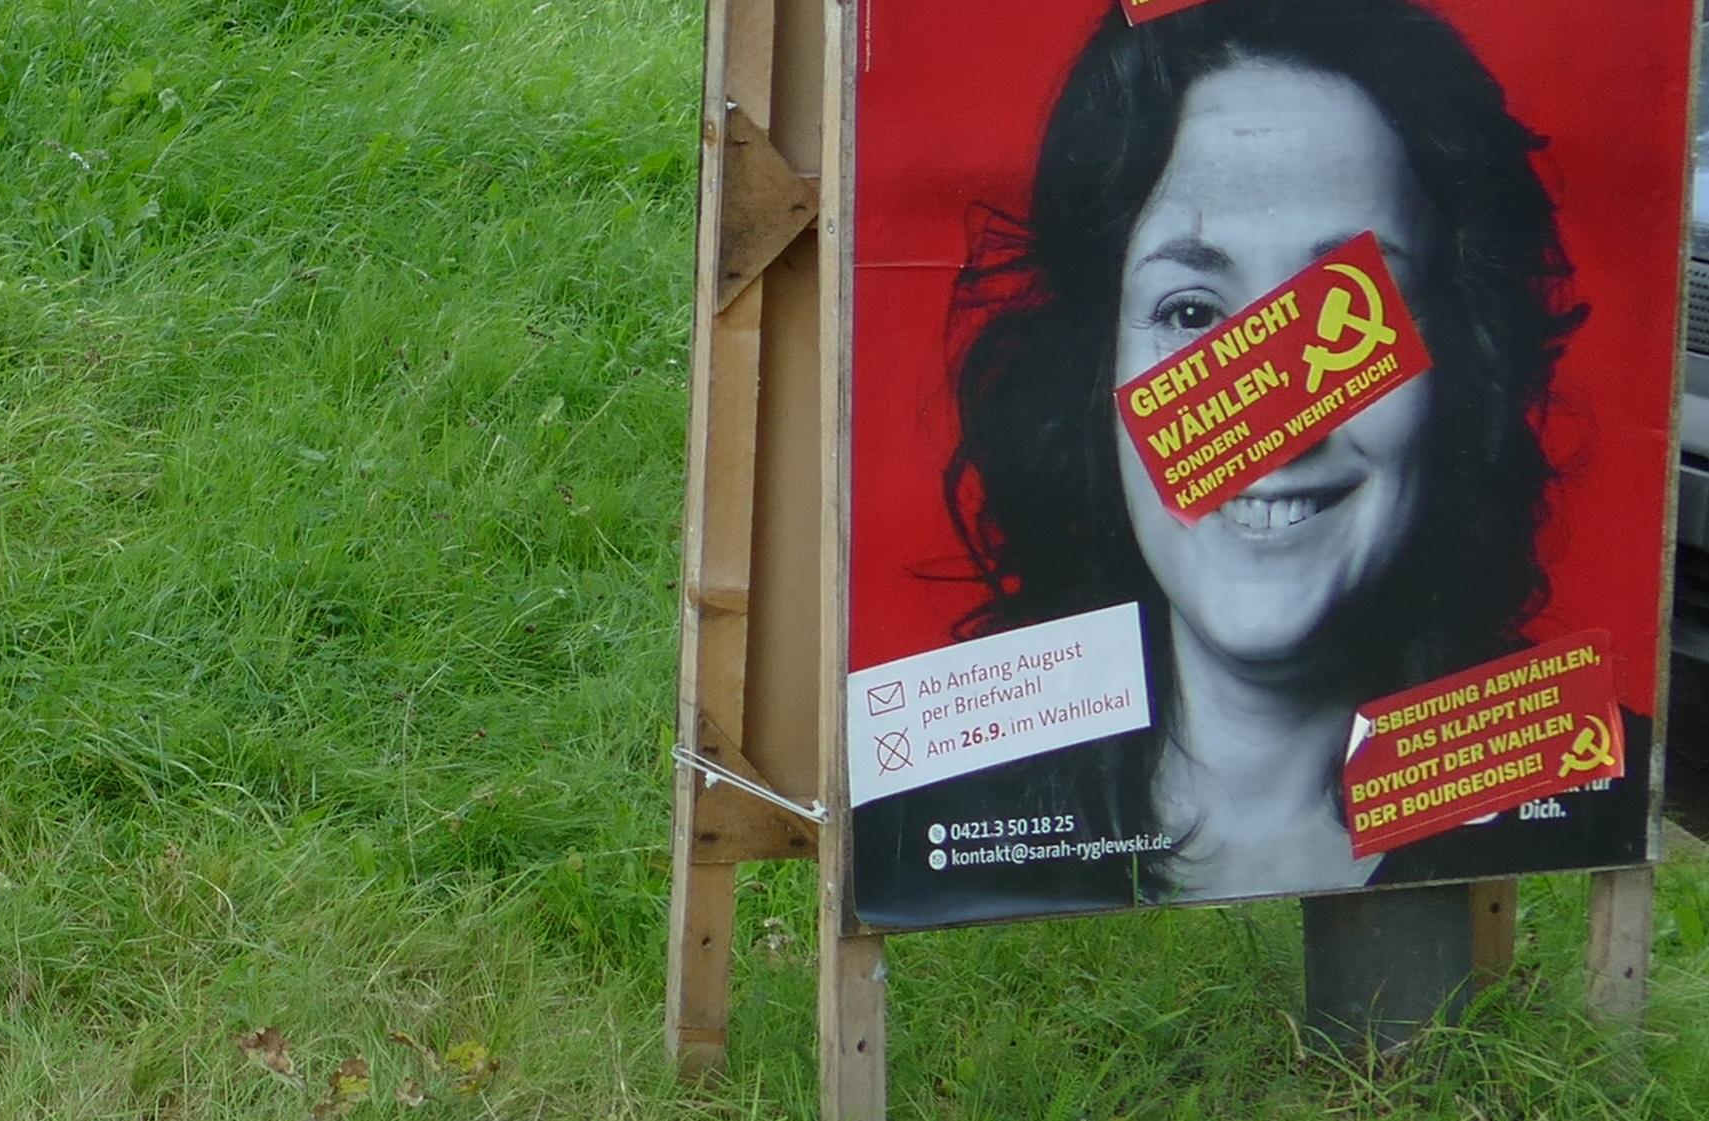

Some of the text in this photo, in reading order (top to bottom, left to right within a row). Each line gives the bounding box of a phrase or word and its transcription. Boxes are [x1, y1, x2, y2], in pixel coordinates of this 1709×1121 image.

[1130, 290, 1301, 417] GEHT NICHT
[1148, 360, 1290, 459] WÄHLEN,
[1175, 353, 1398, 509] KÄMPFT UND WEHRT EUCH!
[1164, 421, 1252, 485] SONDERN
[918, 641, 1084, 698] Ab Anfang August
[921, 676, 1042, 729] per Briefwahl
[1484, 646, 1601, 698] ABWÄHLEN,
[926, 688, 1131, 758] Am 26.9. im Wahllokal
[1396, 687, 1560, 758] DAS KLAPPT NIE!
[1351, 713, 1574, 804] BOYKOTT DER WAHLEN
[1007, 817, 1028, 836] 50
[1031, 816, 1051, 834] 18
[1054, 815, 1075, 832] 25
[1354, 753, 1543, 832] DER BOURGEOISIE!
[1519, 797, 1567, 820] Dich.
[951, 833, 1172, 866] kontakt@sarah-ryglewski.de
